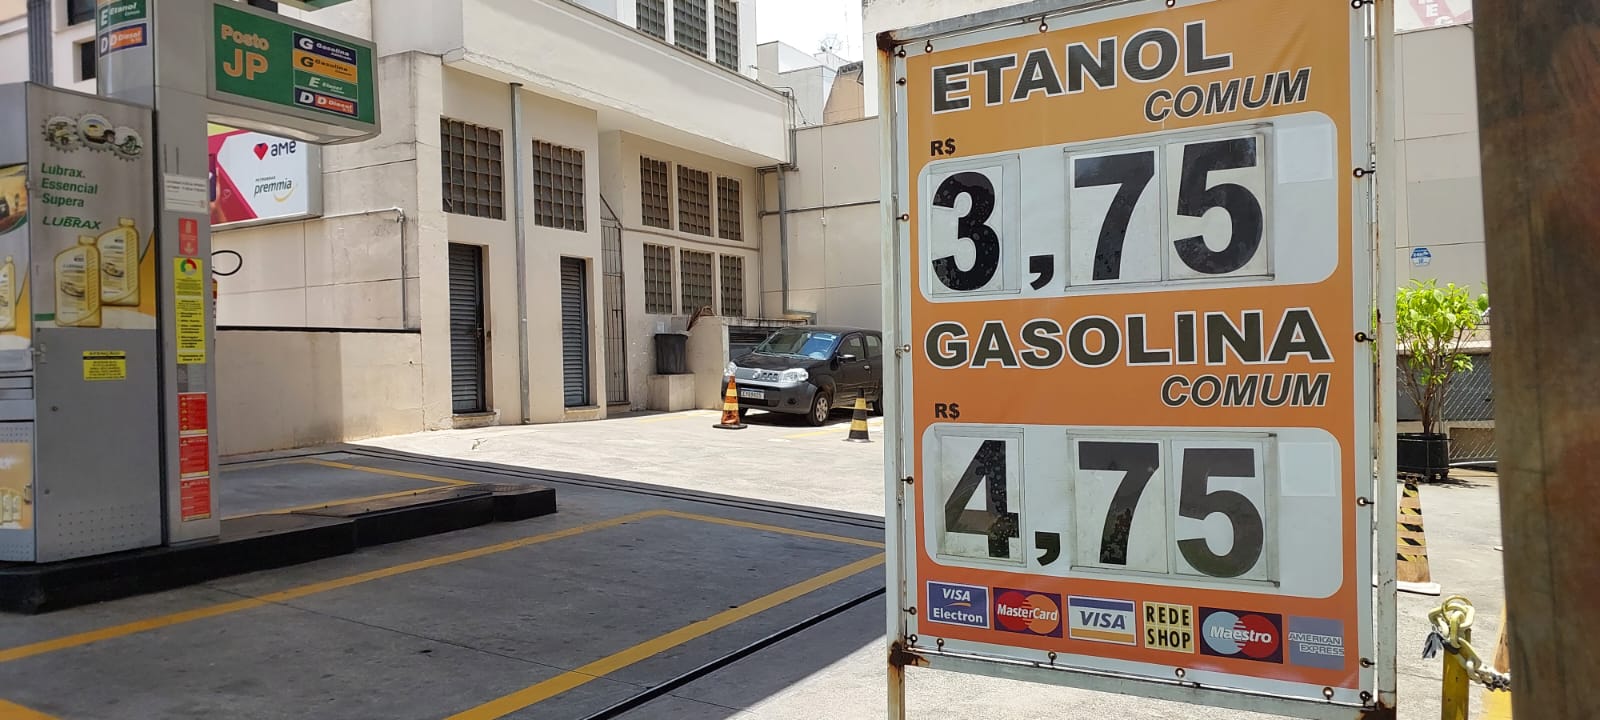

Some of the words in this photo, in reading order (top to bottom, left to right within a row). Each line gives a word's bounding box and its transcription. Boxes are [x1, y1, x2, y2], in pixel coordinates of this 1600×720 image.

[101, 9, 108, 26] E
[101, 36, 108, 53] D
[221, 24, 269, 51] Posto
[299, 37, 314, 50] G
[223, 48, 269, 81] JP
[301, 56, 314, 68] G
[931, 20, 1233, 115] ETANOL
[309, 76, 321, 88] E
[299, 91, 314, 104] D
[317, 95, 327, 105] D
[1144, 66, 1311, 122] COMUM
[930, 139, 956, 156] R$
[41, 163, 86, 178] Lubrax.
[41, 177, 98, 195] Essencial
[254, 177, 292, 198] premmia
[42, 192, 85, 208] Supera
[932, 136, 1264, 291] 3,75
[42, 216, 102, 230] LUBRAX
[924, 307, 1335, 369] GASOLINA
[1160, 373, 1331, 407] COMUM
[934, 403, 960, 420] R$
[944, 439, 1264, 578] 4,75
[942, 587, 972, 602] VISA
[933, 607, 984, 624] Electron
[996, 603, 1059, 622] MasterCard
[1079, 610, 1127, 630] VISA
[1145, 605, 1190, 626] REDE
[1147, 628, 1191, 649] SHOP
[1209, 625, 1272, 643] Maestro
[1287, 631, 1342, 646] AMERICAN
[1299, 644, 1345, 657] EXPRESS
